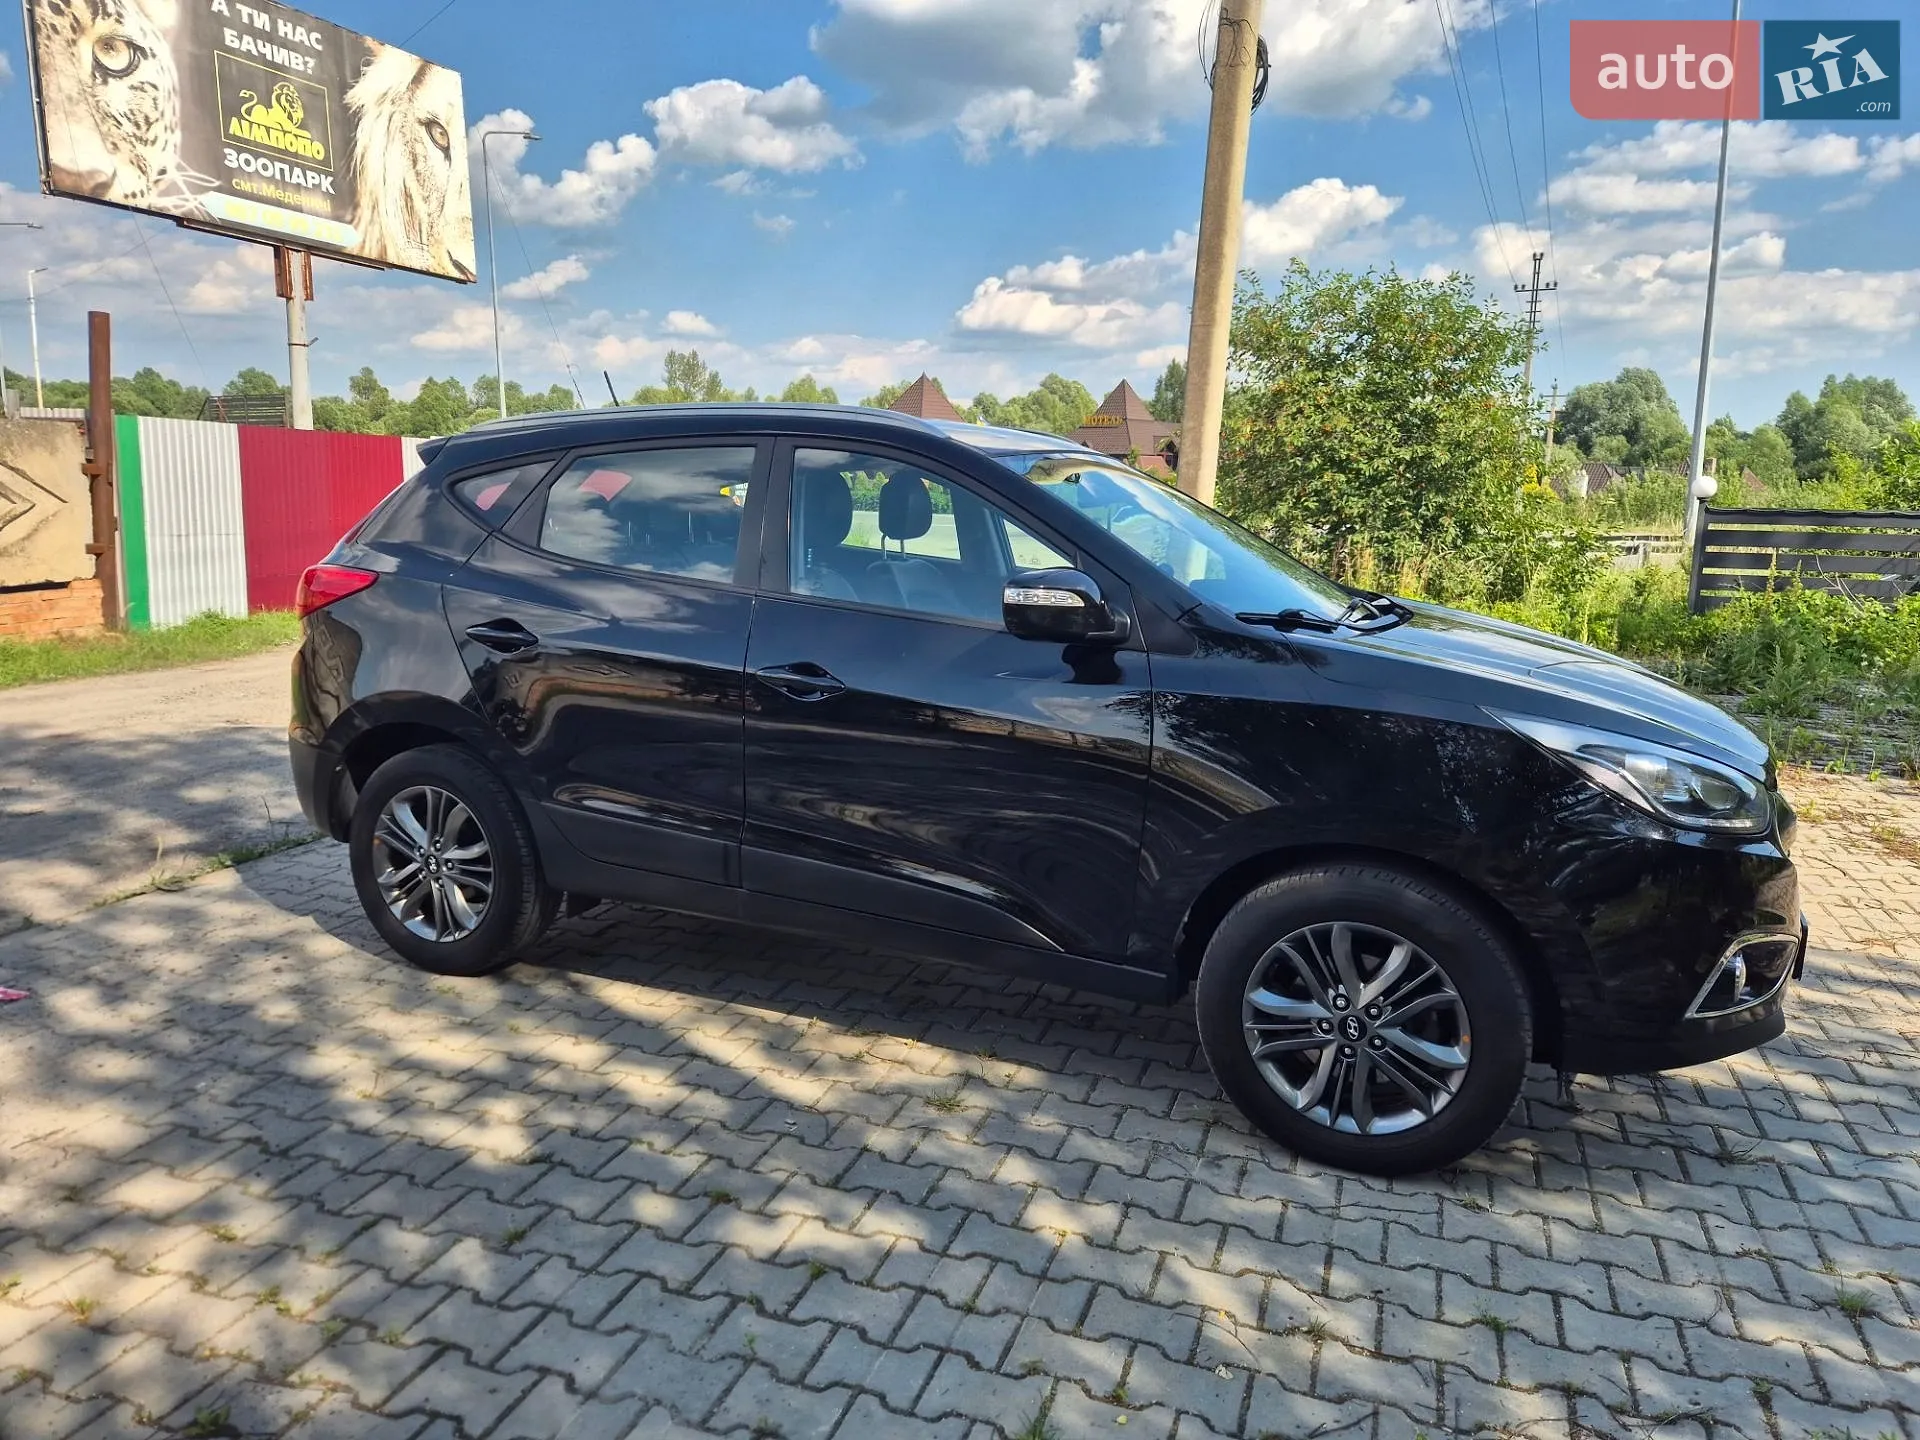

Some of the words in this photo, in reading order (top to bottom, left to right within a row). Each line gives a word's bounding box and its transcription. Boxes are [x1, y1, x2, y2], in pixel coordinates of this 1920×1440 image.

[211, 0, 230, 17] А
[236, 3, 271, 32] ТИ
[276, 19, 324, 51] НАС
[223, 27, 317, 75] БАЧИВ?
[229, 117, 325, 161] ЛІМПОПО
[223, 148, 336, 195] ЗООПАРК
